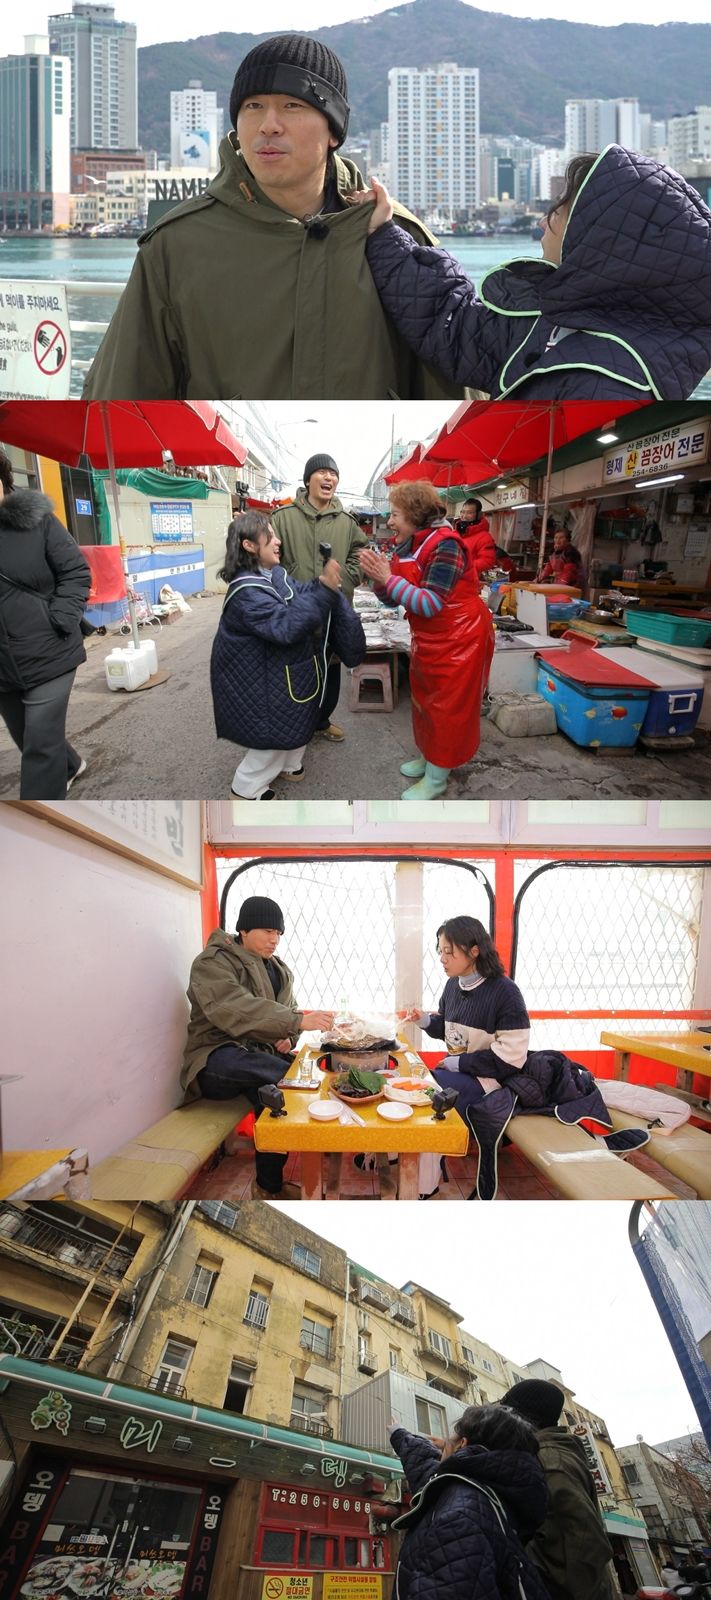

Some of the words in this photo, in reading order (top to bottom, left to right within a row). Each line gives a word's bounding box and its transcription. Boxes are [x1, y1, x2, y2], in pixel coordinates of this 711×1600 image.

[5, 294, 25, 309] 먹이를
[606, 456, 623, 476] 형제
[627, 452, 637, 470] 산
[641, 441, 676, 466] 꼼장어
[677, 432, 705, 458] 전문
[191, 1536, 212, 1592] BAR
[289, 1577, 308, 1586] 청소년
